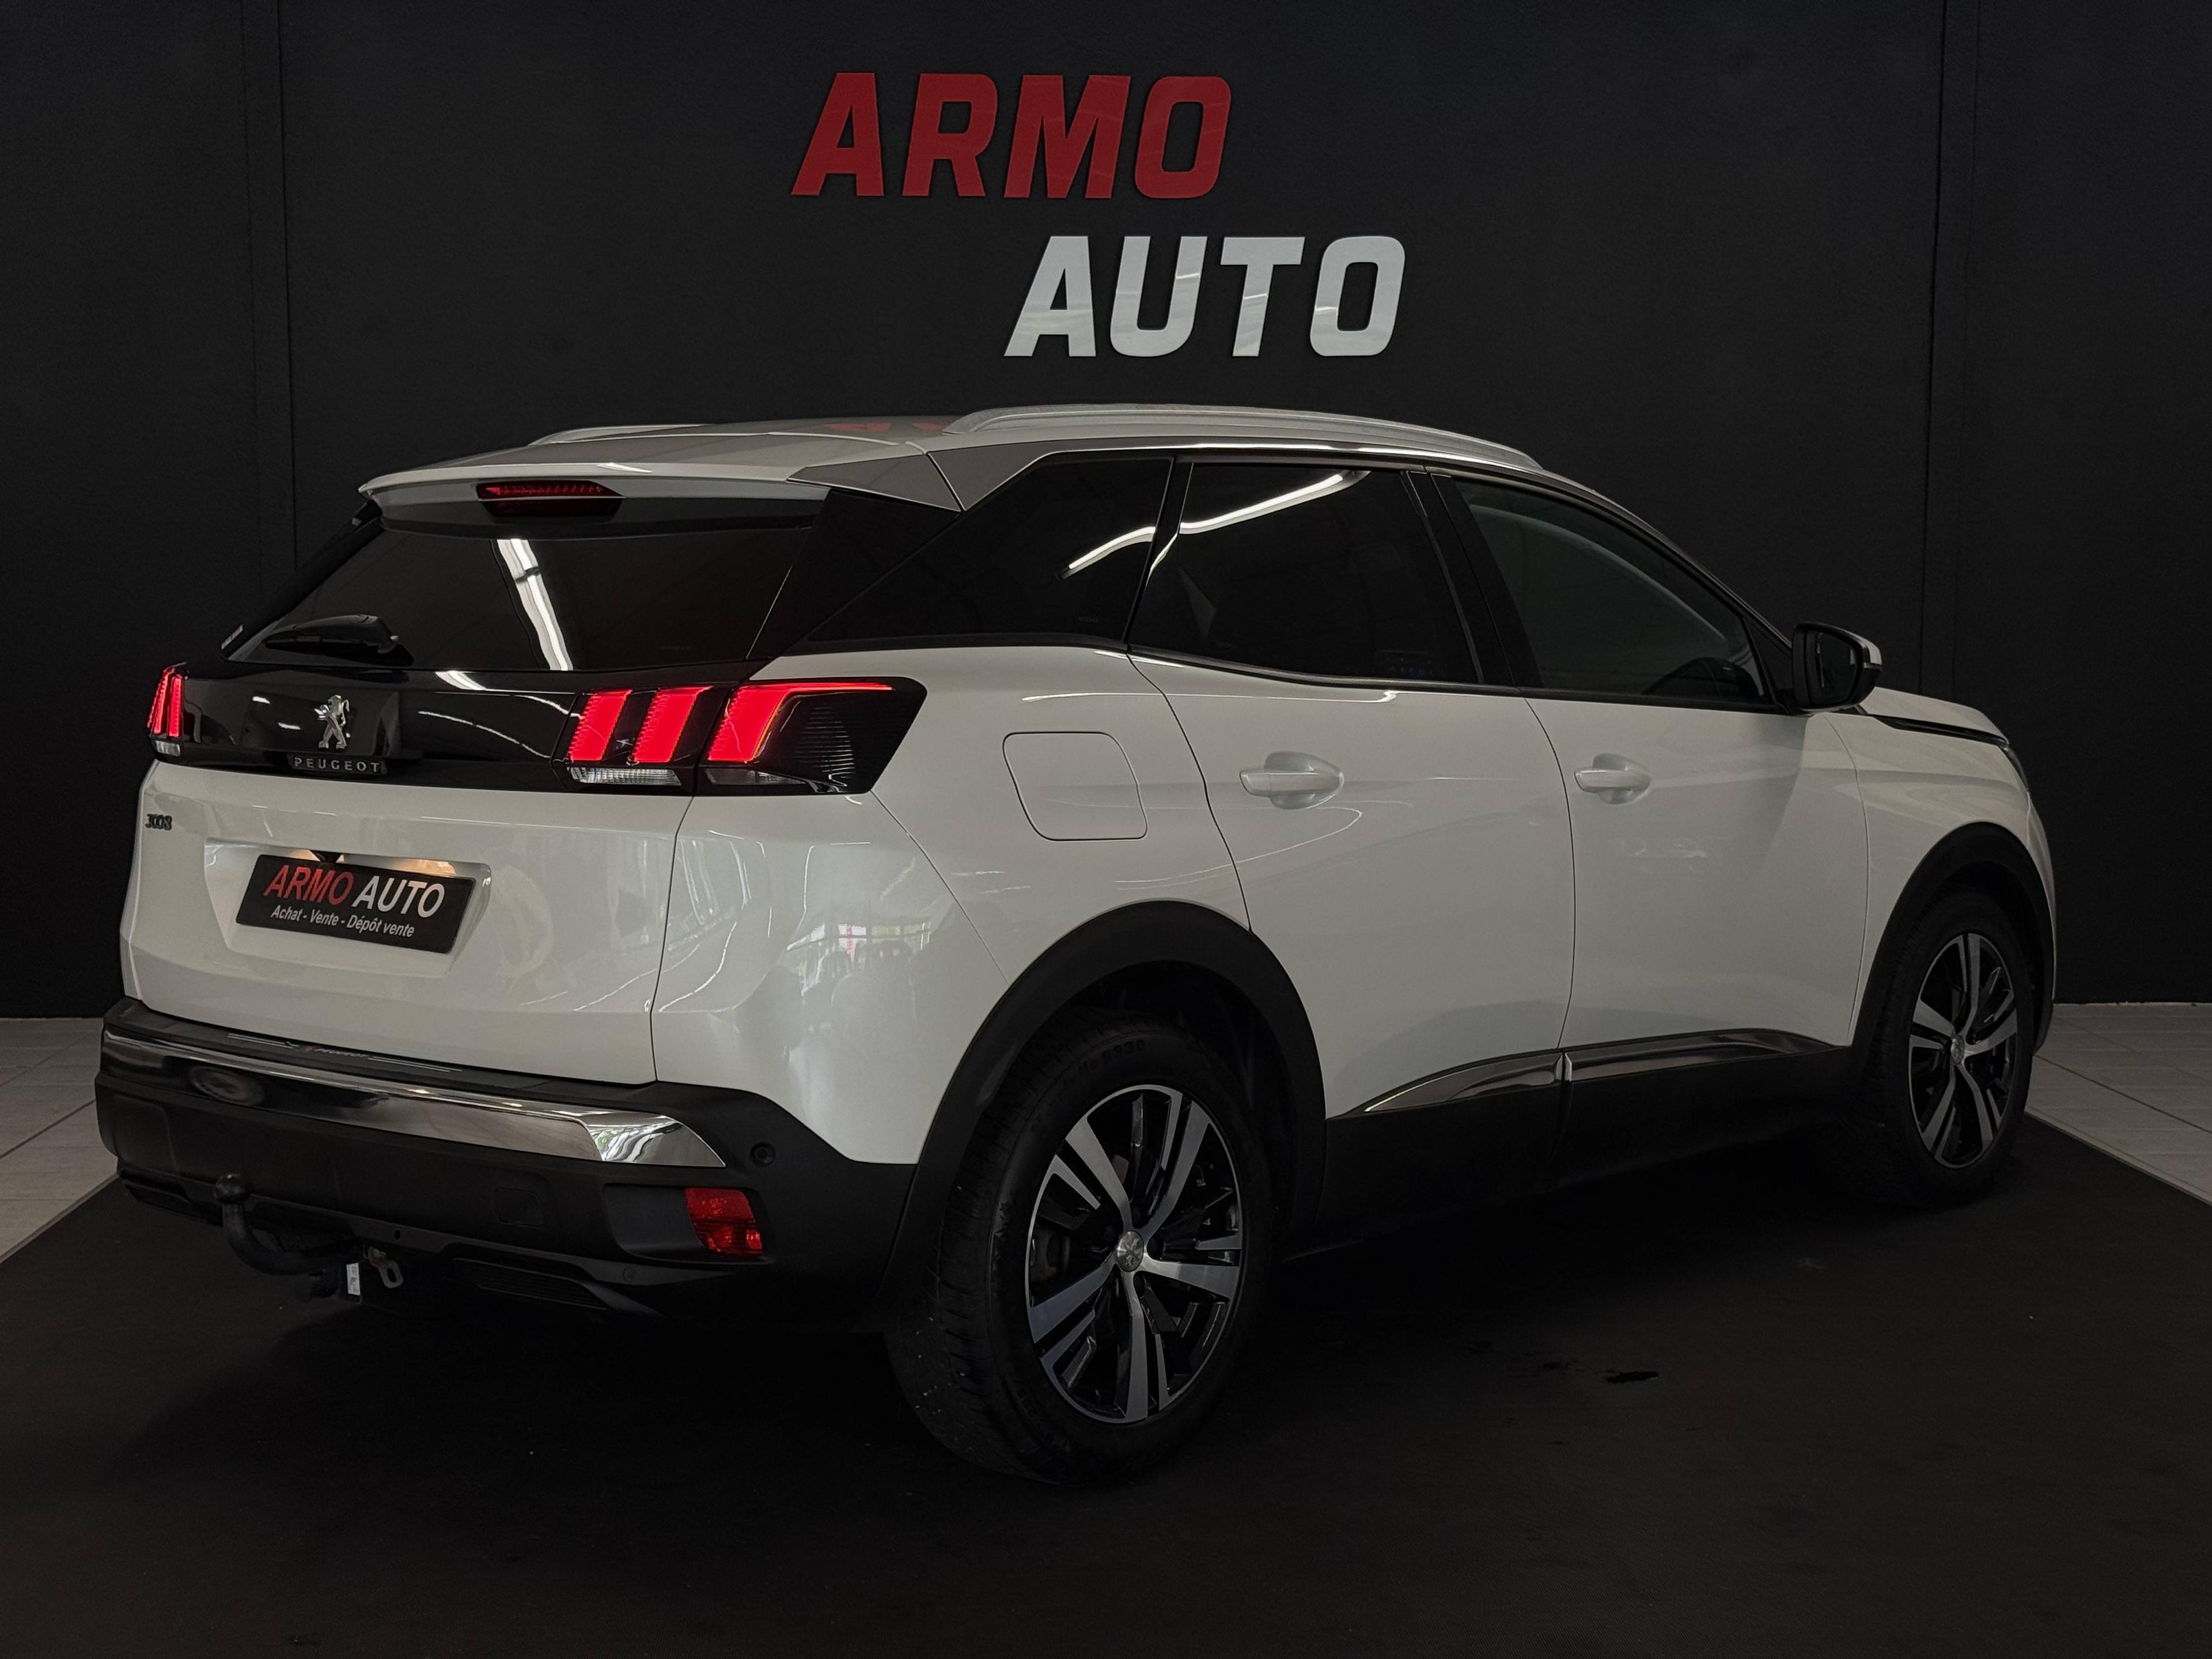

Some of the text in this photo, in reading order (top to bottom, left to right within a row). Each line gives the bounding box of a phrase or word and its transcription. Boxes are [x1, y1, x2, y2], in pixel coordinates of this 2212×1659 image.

[791, 71, 1232, 199] ARMO
[1003, 236, 1406, 357] AUTO
[294, 757, 380, 772] PEUGEOT
[263, 865, 445, 918] ARMO AUTO
[270, 905, 303, 921] Achat
[310, 909, 339, 926] Vente
[347, 915, 382, 934] Dépôt
[382, 922, 415, 938] vente
